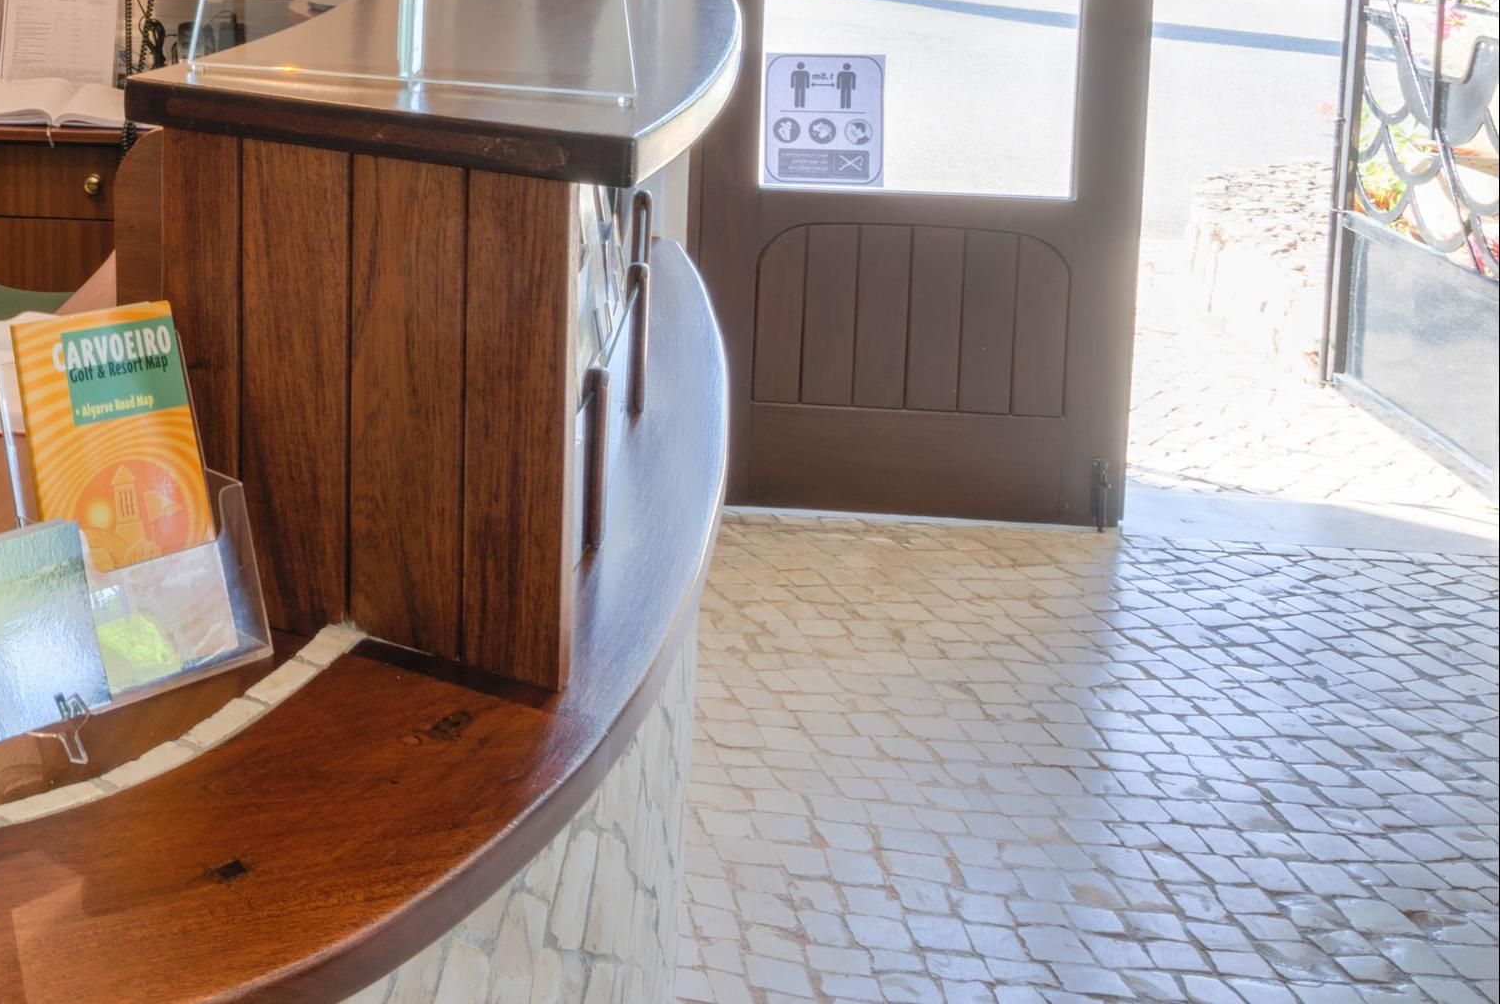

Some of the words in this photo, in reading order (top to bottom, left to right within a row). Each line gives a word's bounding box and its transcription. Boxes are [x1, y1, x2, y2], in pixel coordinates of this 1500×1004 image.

[52, 325, 172, 372] CARVOEIRO
[70, 363, 94, 384] Golf
[97, 365, 106, 379] &
[109, 357, 143, 377] Resort
[146, 355, 168, 372] Map
[82, 402, 114, 420] Algarve
[115, 396, 135, 411] Road
[136, 394, 155, 409] Map
